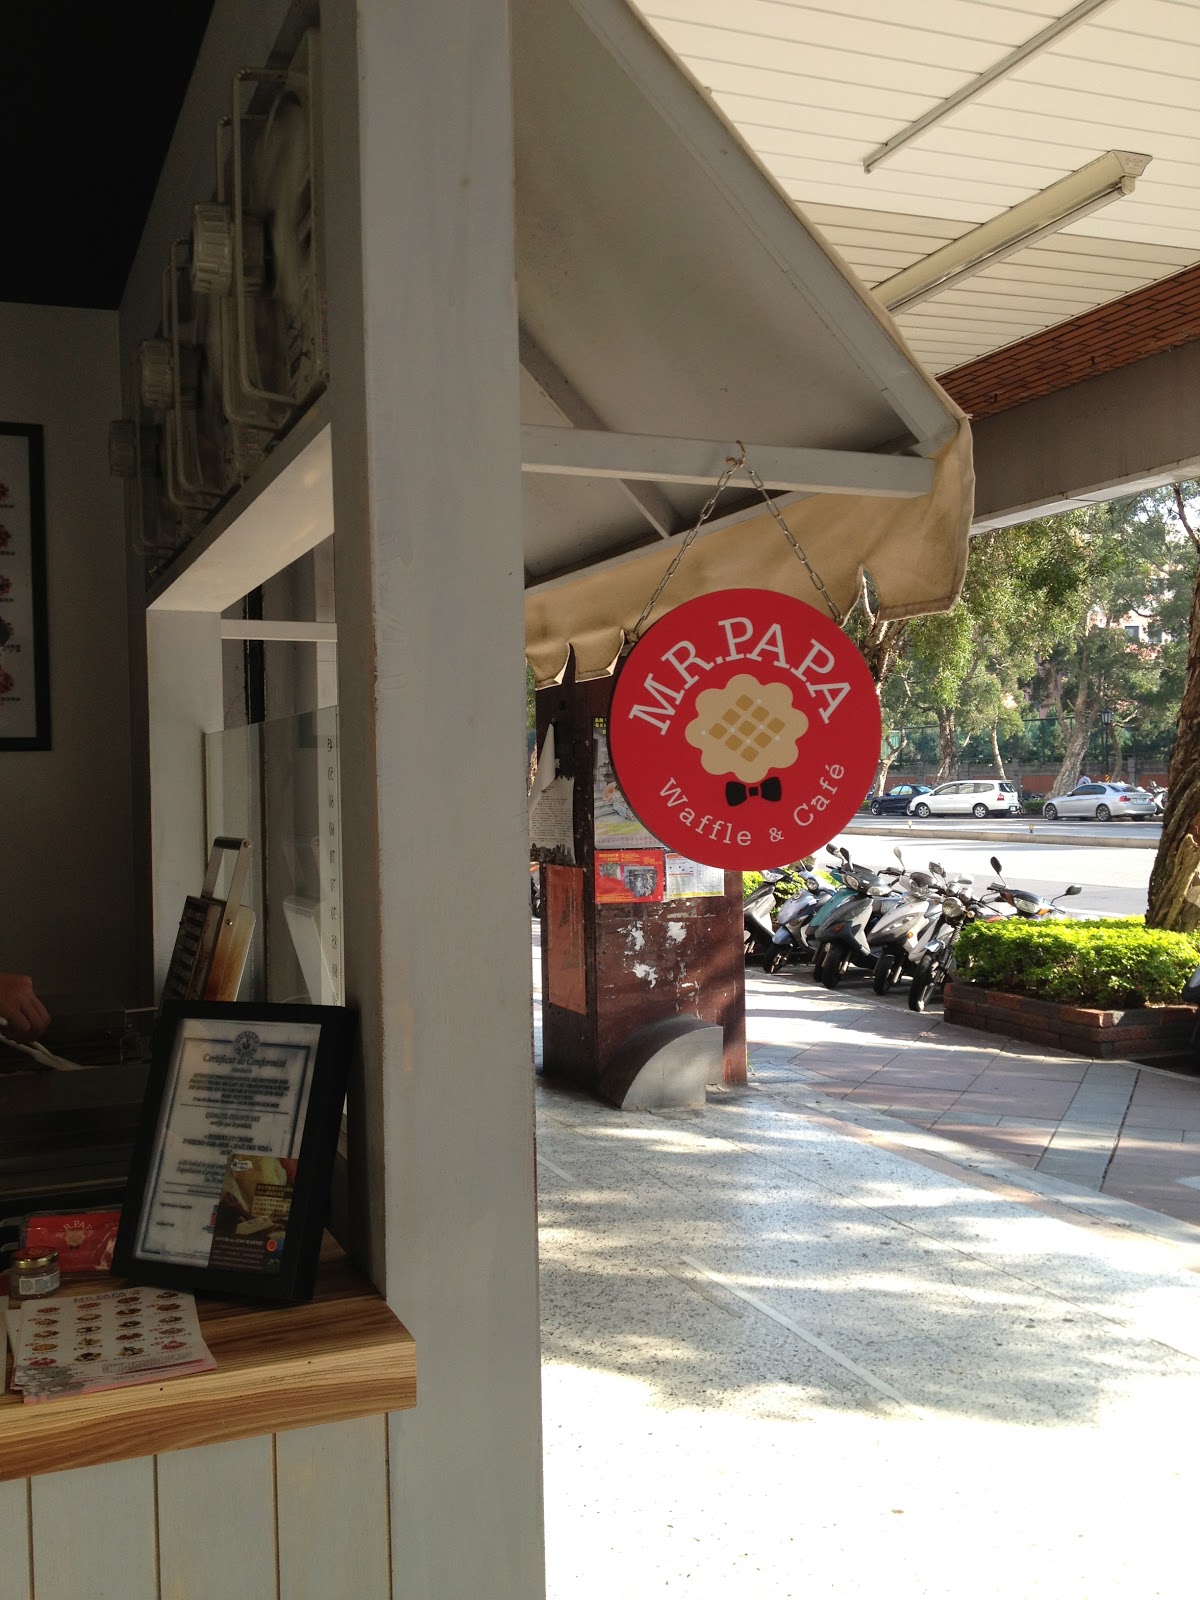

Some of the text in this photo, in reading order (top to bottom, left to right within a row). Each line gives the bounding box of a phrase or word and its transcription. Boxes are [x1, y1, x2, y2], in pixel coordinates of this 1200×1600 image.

[659, 763, 845, 846] Waffle & Café
[203, 1053, 236, 1066] Certificat
